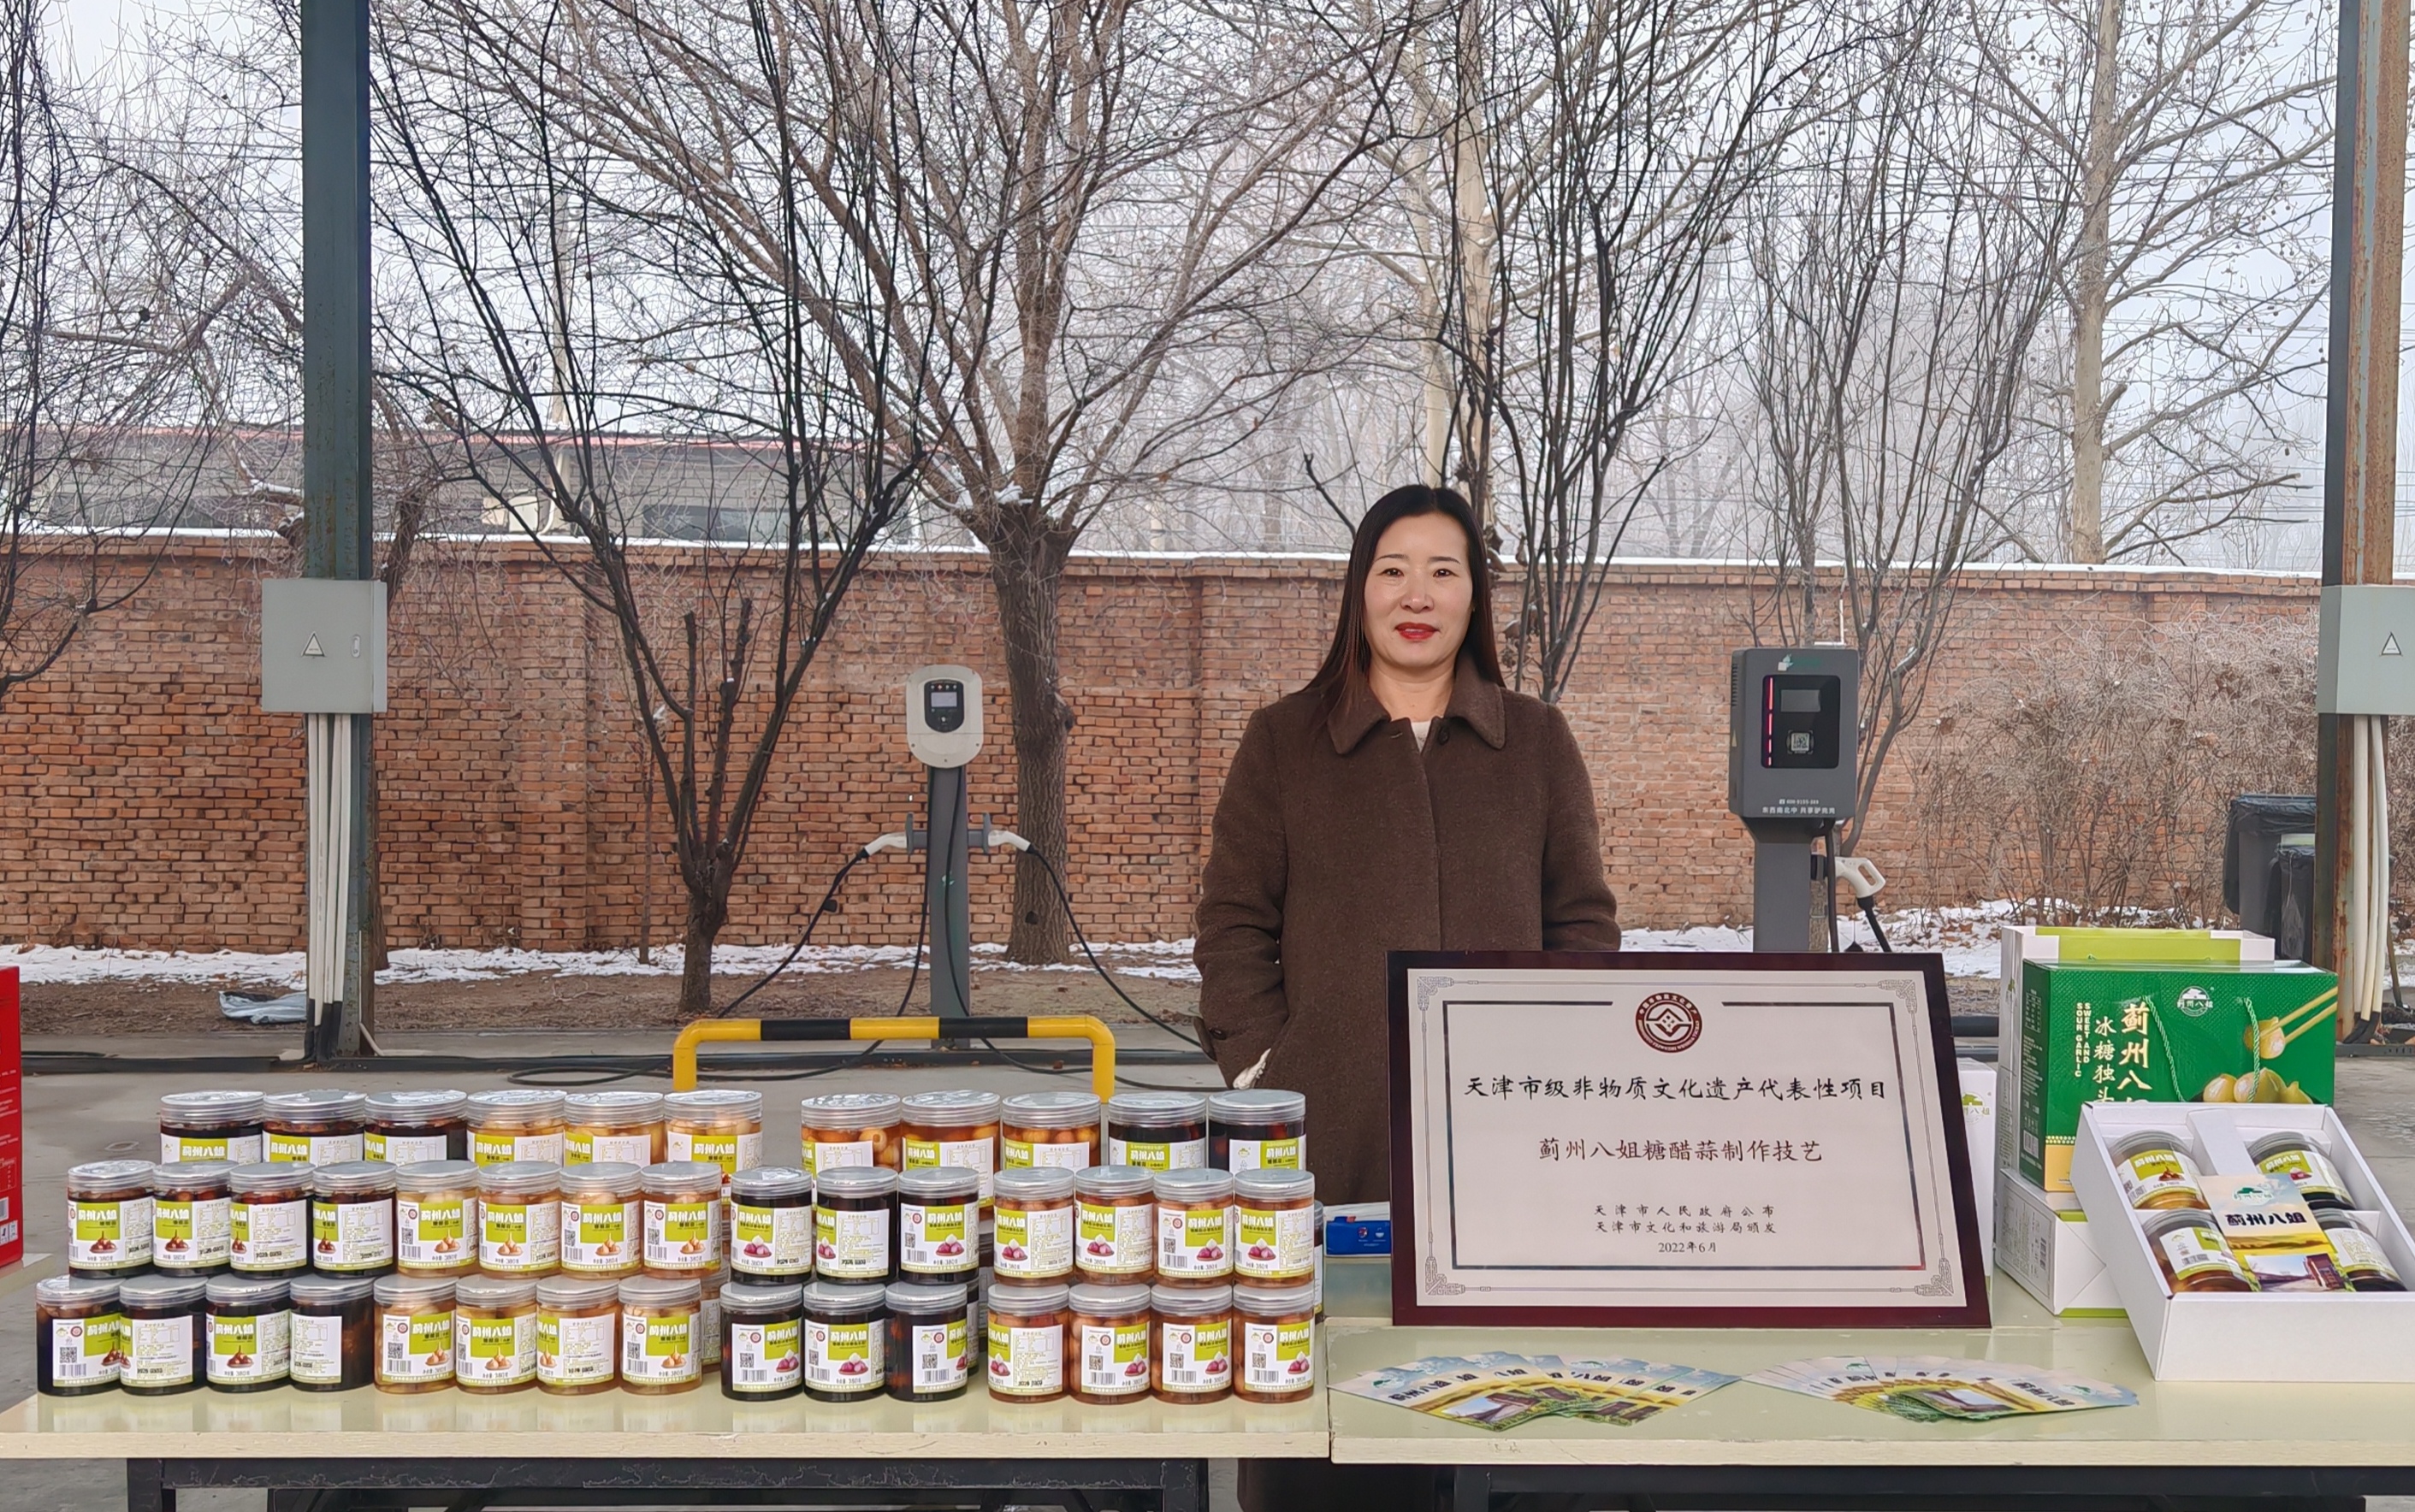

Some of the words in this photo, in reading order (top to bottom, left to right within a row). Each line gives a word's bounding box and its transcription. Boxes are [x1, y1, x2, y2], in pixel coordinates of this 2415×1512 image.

[2083, 1002, 2092, 1039] SWEET
[2075, 1035, 2083, 1078] GARLIC
[2117, 1001, 2152, 1102] 蓟州八
[1464, 1075, 1885, 1101] 天津市级非物质文化遗产代表性项目
[1539, 1137, 1822, 1162] 蓟州八姐糖醋蒜制作技艺
[1594, 1203, 1775, 1218] 天津市人民政府公布
[2225, 1212, 2307, 1226] 蓟州八姐
[1595, 1220, 1777, 1233] 天津市文化和旅游局颁发
[1658, 1241, 1717, 1254] 2022年6月
